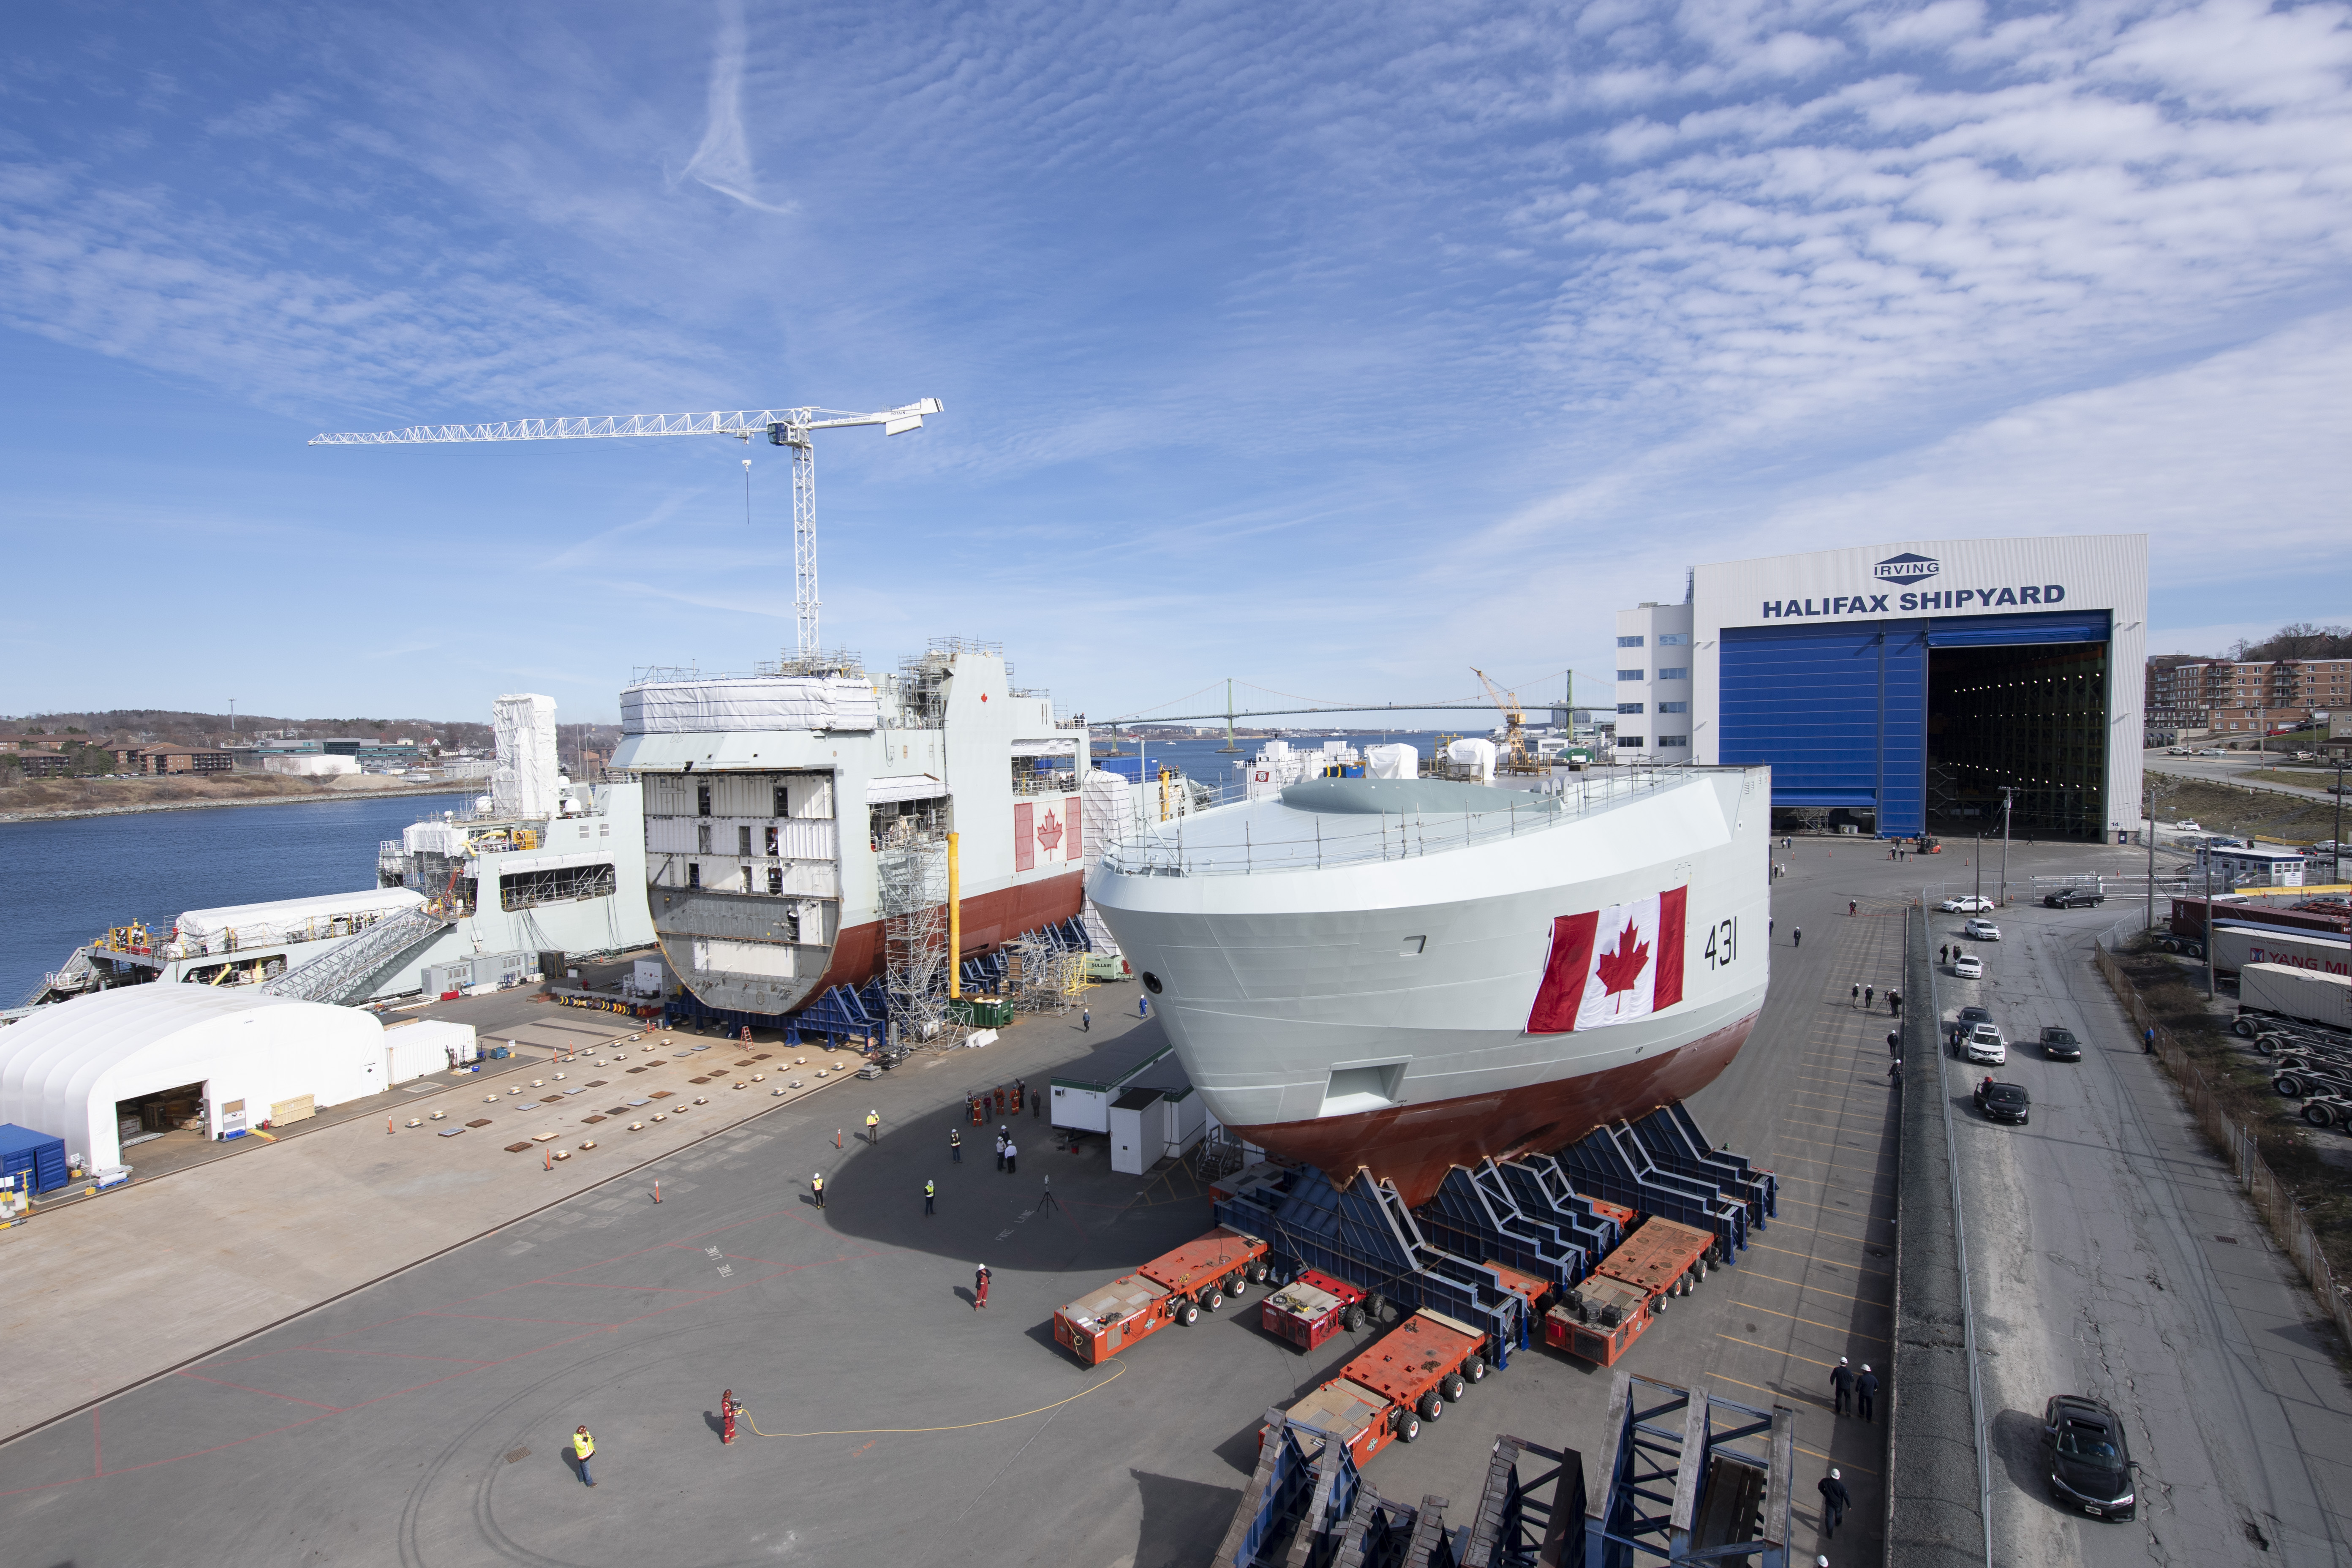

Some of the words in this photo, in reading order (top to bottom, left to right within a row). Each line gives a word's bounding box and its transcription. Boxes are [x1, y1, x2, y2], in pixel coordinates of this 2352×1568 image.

[1874, 561, 1940, 576] IRVING
[1763, 594, 1889, 618] HALIFAX
[1900, 585, 2065, 610] SHIPYARD
[1704, 915, 1737, 970] 431
[2269, 951, 2318, 971] YANG
[2325, 960, 2352, 976] MI
[994, 1229, 1014, 1241] FIRE
[1014, 1209, 1035, 1223] LANE
[705, 1246, 723, 1260] LANE
[717, 1264, 734, 1278] FIRE
